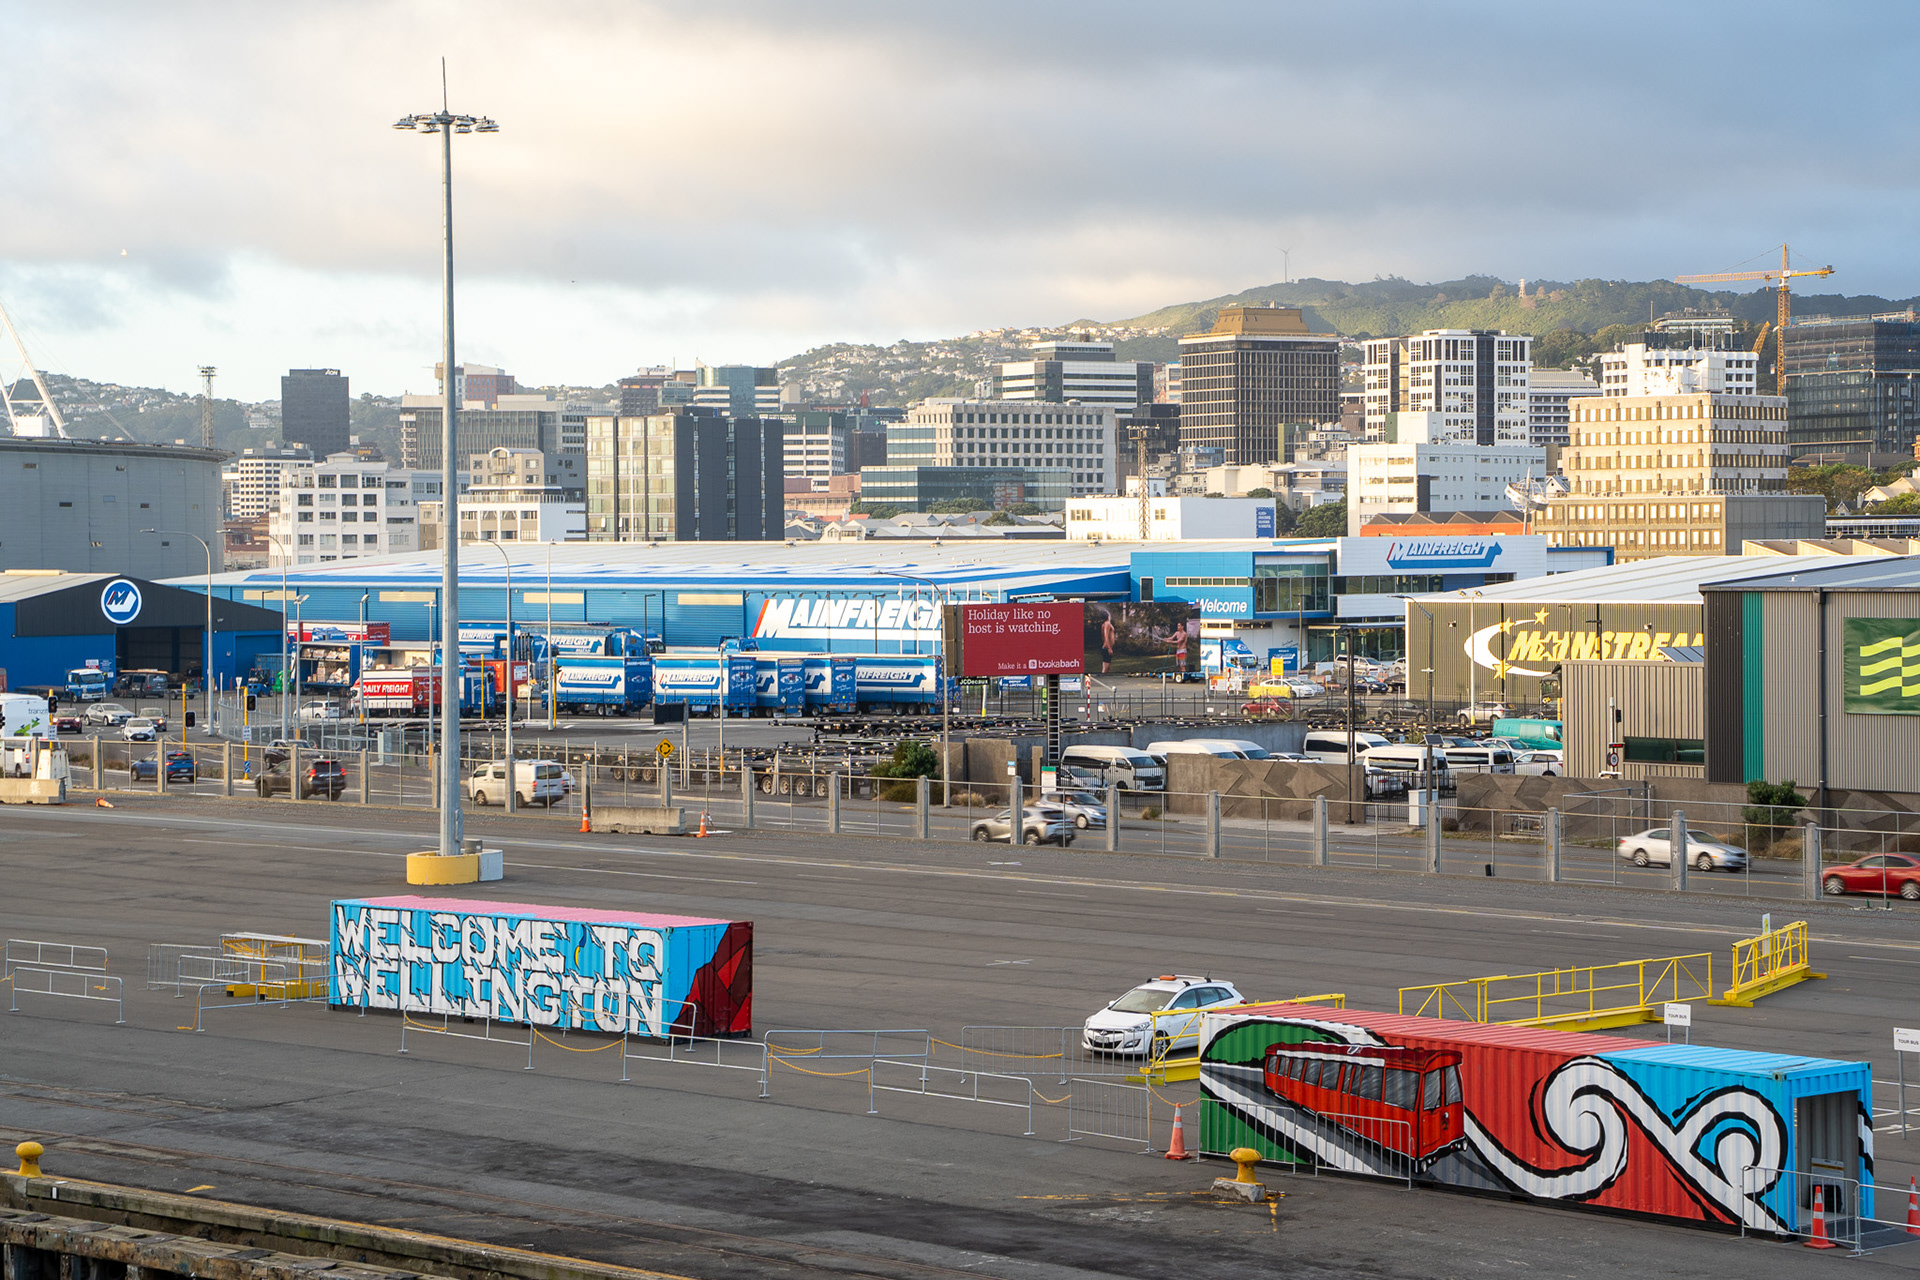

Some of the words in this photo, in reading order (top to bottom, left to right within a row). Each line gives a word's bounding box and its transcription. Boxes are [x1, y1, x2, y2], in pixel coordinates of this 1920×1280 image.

[1386, 541, 1491, 561] MAINFREIGHT
[1199, 598, 1248, 613] Welcome
[968, 609, 1010, 622] Holiday
[1013, 608, 1034, 620] like
[1037, 610, 1051, 619] no
[968, 623, 992, 634] host
[996, 622, 1005, 633] is
[1008, 621, 1061, 635] watching.
[1508, 631, 1704, 661] MAINSTREA
[998, 662, 1015, 670] Make
[1038, 659, 1080, 669] bookabach
[363, 684, 382, 693] DAILY
[382, 684, 409, 693] FREIGHT
[335, 904, 570, 973] WELCOME
[586, 922, 663, 984] TO
[335, 951, 663, 1037] WELLINGTON
